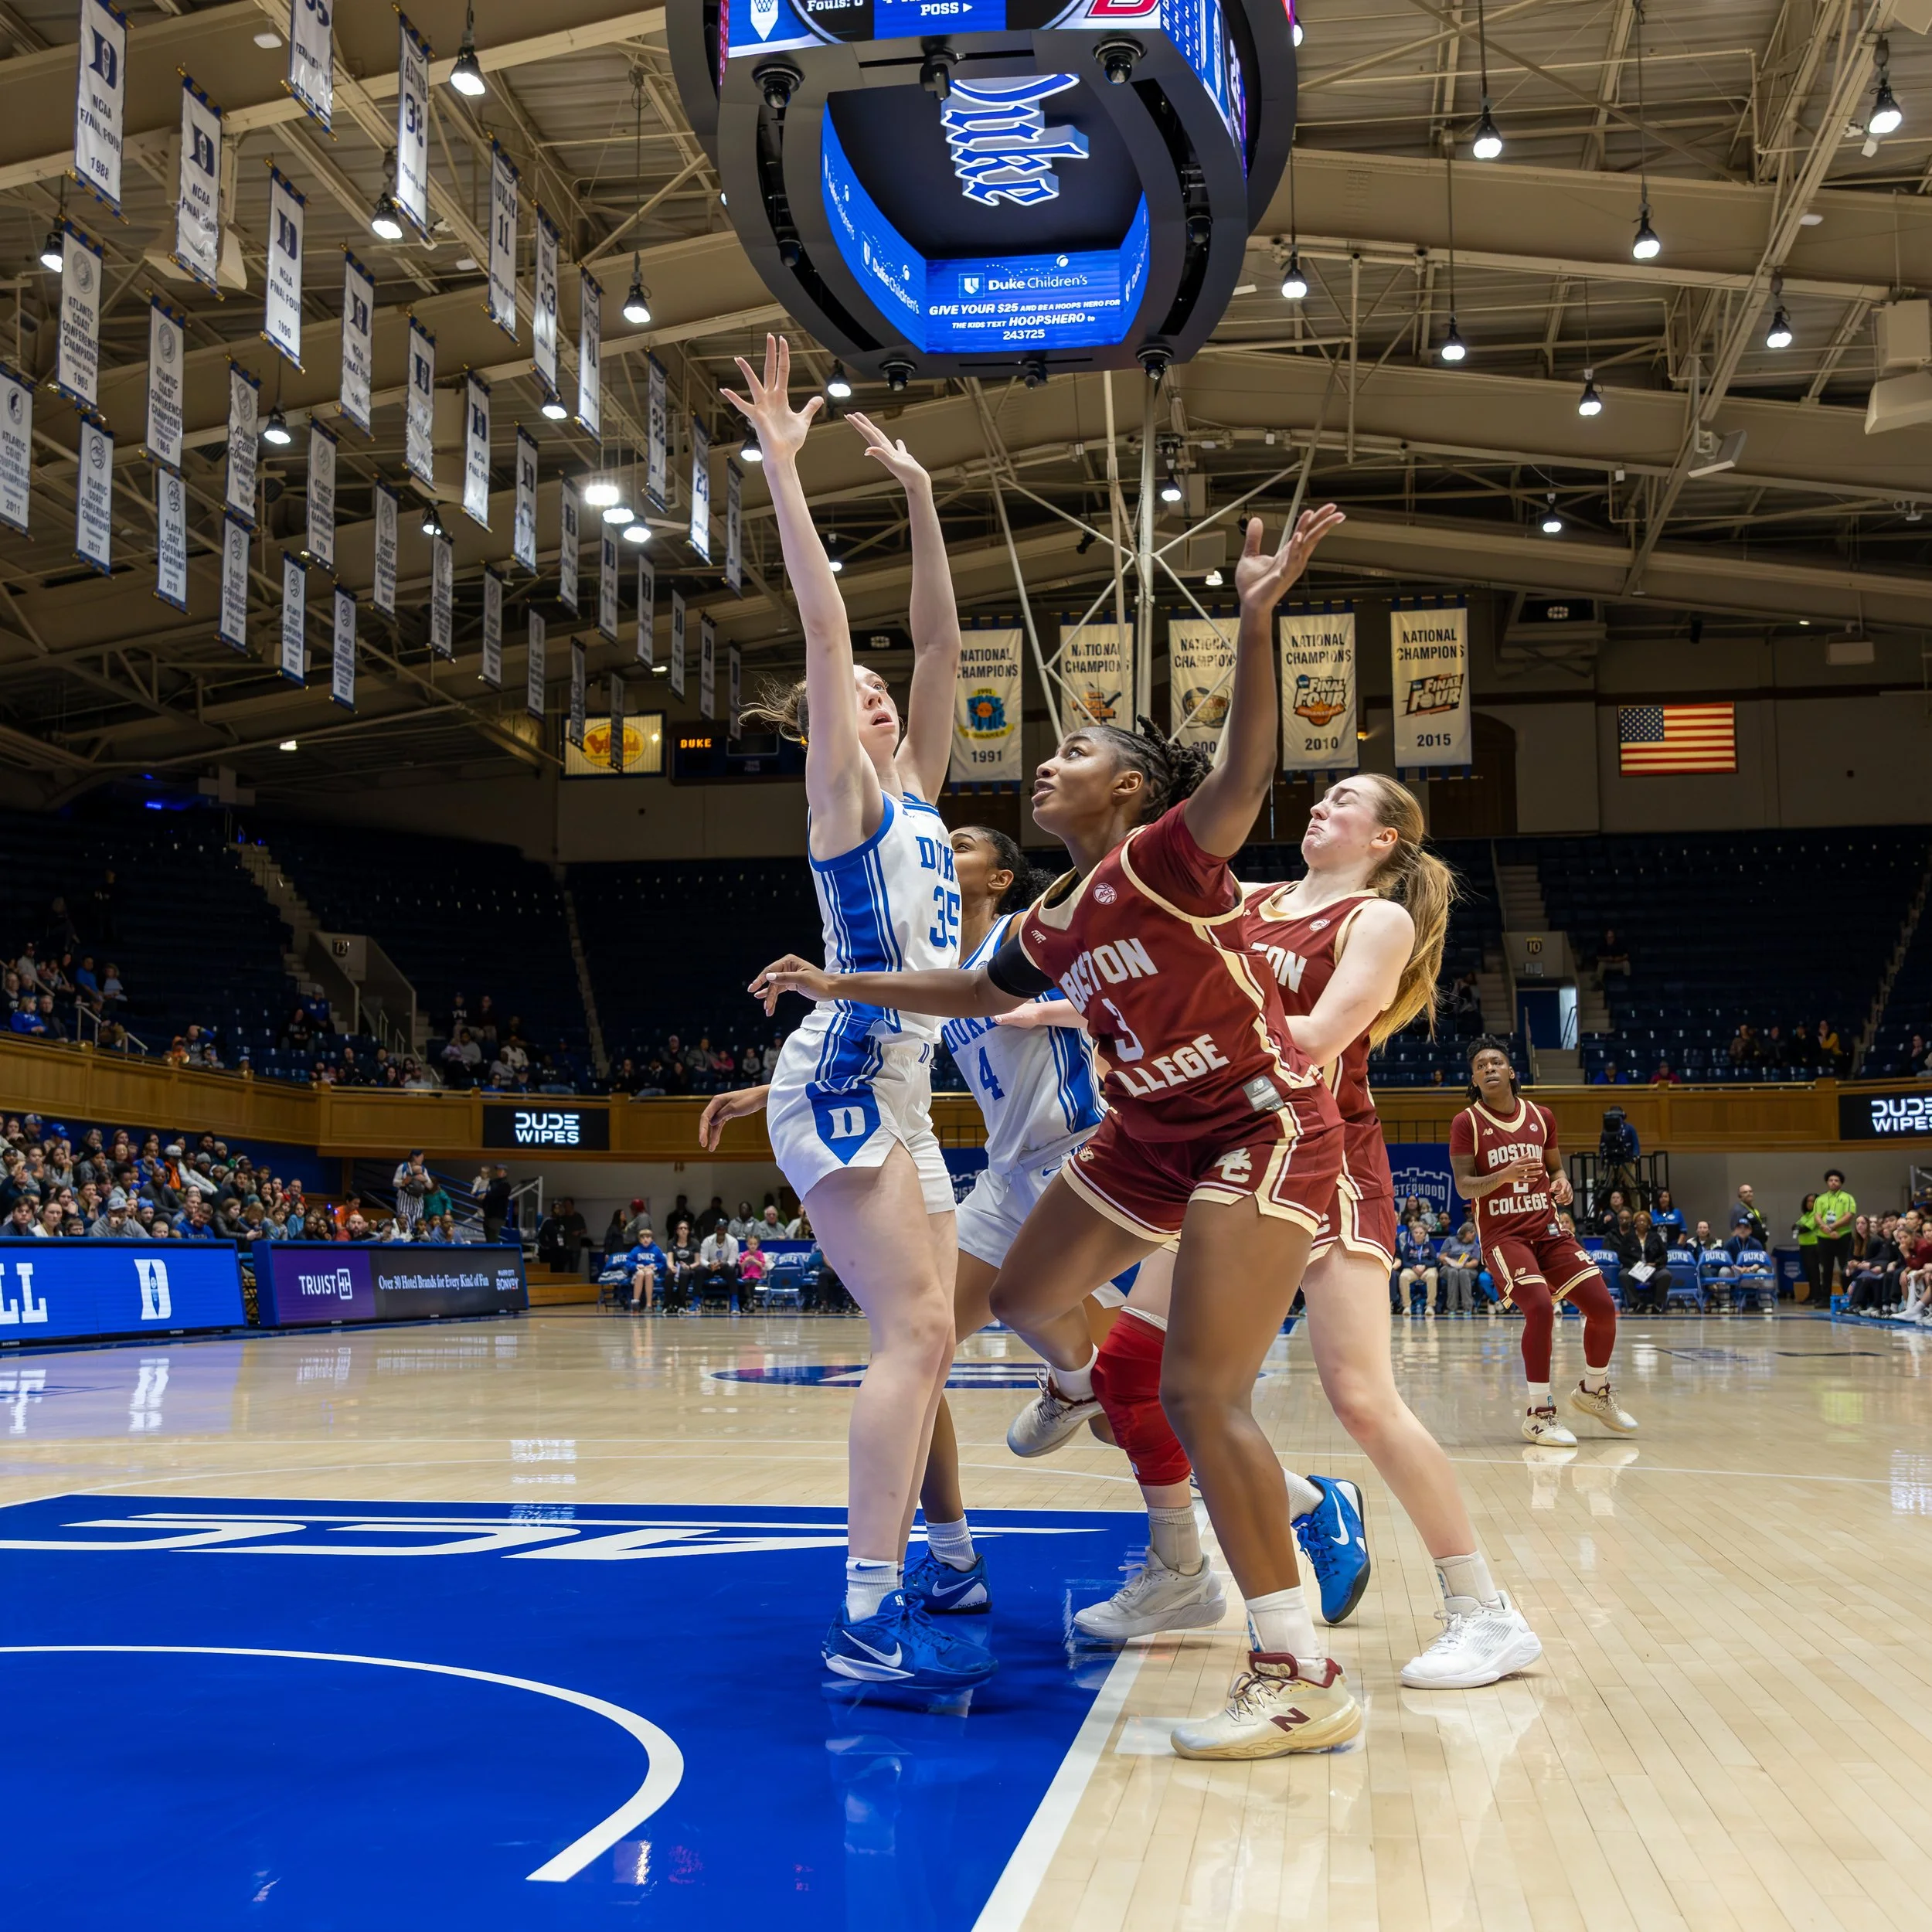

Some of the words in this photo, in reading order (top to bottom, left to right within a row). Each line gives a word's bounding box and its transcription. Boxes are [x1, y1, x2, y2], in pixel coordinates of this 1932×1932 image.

[920, 2, 959, 16] POSS
[92, 94, 113, 122] NCAA
[80, 108, 103, 138] FINAL
[192, 183, 210, 207] NCAA
[279, 267, 293, 288] NCAA
[988, 278, 1026, 291] Duke
[1026, 274, 1088, 290] Children's
[873, 257, 889, 287] Duke
[889, 277, 920, 315] Children's
[68, 296, 94, 323] ATLANTIC
[929, 305, 958, 316] GIVE
[961, 304, 995, 315] YOUR
[998, 303, 1019, 314] $25
[1056, 302, 1081, 311] HOOPS
[1083, 301, 1104, 309] HERO
[1009, 313, 1086, 327] HOOPSHERO
[1003, 328, 1046, 341] 243725
[1291, 634, 1345, 648] NATIONAL
[1403, 628, 1458, 644] NATIONAL
[961, 648, 1013, 662] NATIONAL
[1286, 649, 1352, 665] CHAMPIONS
[1397, 645, 1464, 662] CHAMPIONS
[957, 664, 1019, 679] HAMPIONS
[1309, 675, 1346, 693] FINAL
[1423, 676, 1462, 695] FINAL
[1294, 690, 1347, 709] FOUR
[680, 738, 712, 750] DUKE
[1303, 736, 1338, 751] 2010
[1417, 733, 1451, 747] 2015
[971, 750, 1002, 764] 1991
[930, 886, 960, 953] 35
[1529, 943, 1541, 953] 10
[1101, 998, 1145, 1063] 3
[978, 1046, 1005, 1101] 4
[515, 1113, 580, 1130] DUDE
[827, 1106, 866, 1140] D
[515, 1130, 580, 1144] WIPES
[1488, 1192, 1549, 1216] COLLEGE
[613, 1253, 627, 1263] DUK
[636, 1253, 655, 1261] DUKE
[778, 1255, 798, 1265] DUKE
[1667, 1251, 1689, 1264] DUKE
[1705, 1250, 1726, 1262] DUKE
[1743, 1250, 1765, 1263] DUKE
[298, 1275, 337, 1296] TRUIST
[378, 1275, 393, 1290] Over
[401, 1275, 417, 1289] Hotel
[417, 1274, 437, 1289] Brands
[445, 1274, 460, 1291] Every
